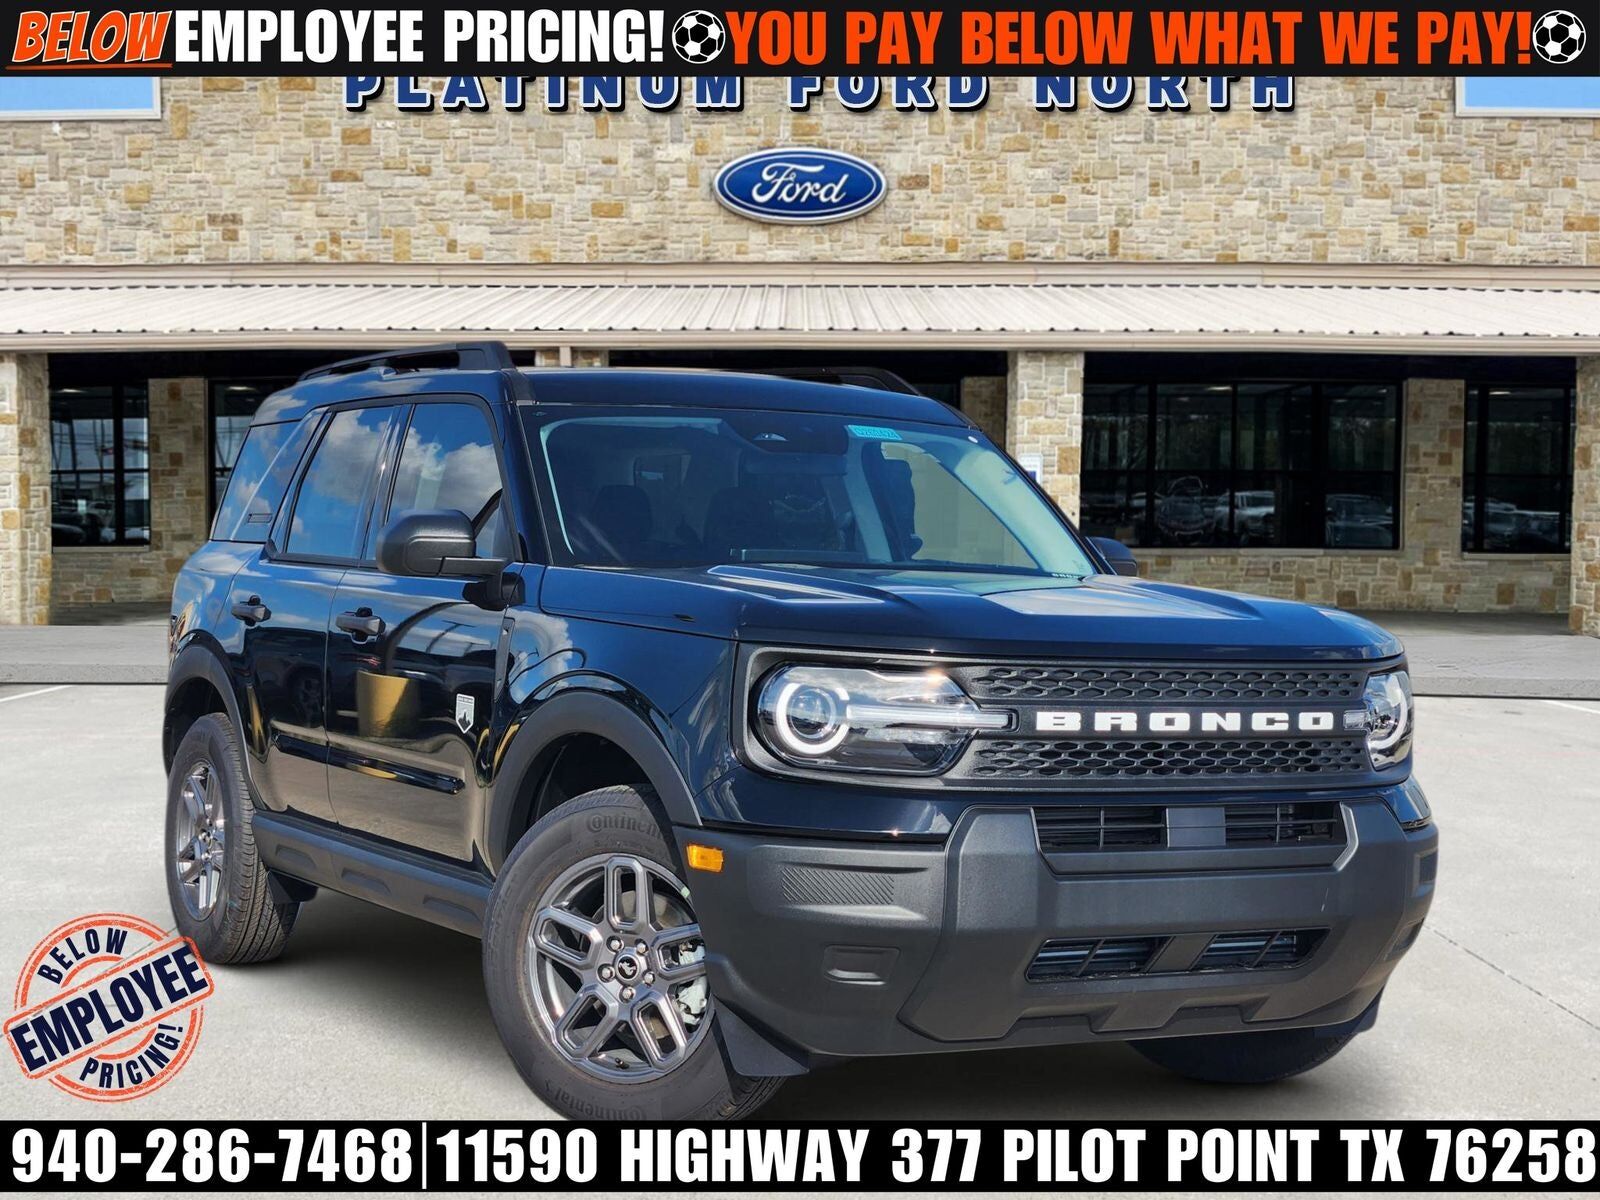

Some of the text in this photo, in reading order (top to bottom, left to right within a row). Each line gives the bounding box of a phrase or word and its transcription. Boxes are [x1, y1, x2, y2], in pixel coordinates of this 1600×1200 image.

[344, 76, 1296, 110] PLATINUM FORD NORTH
[752, 162, 849, 203] Ford
[1036, 711, 1334, 732] BRONCO
